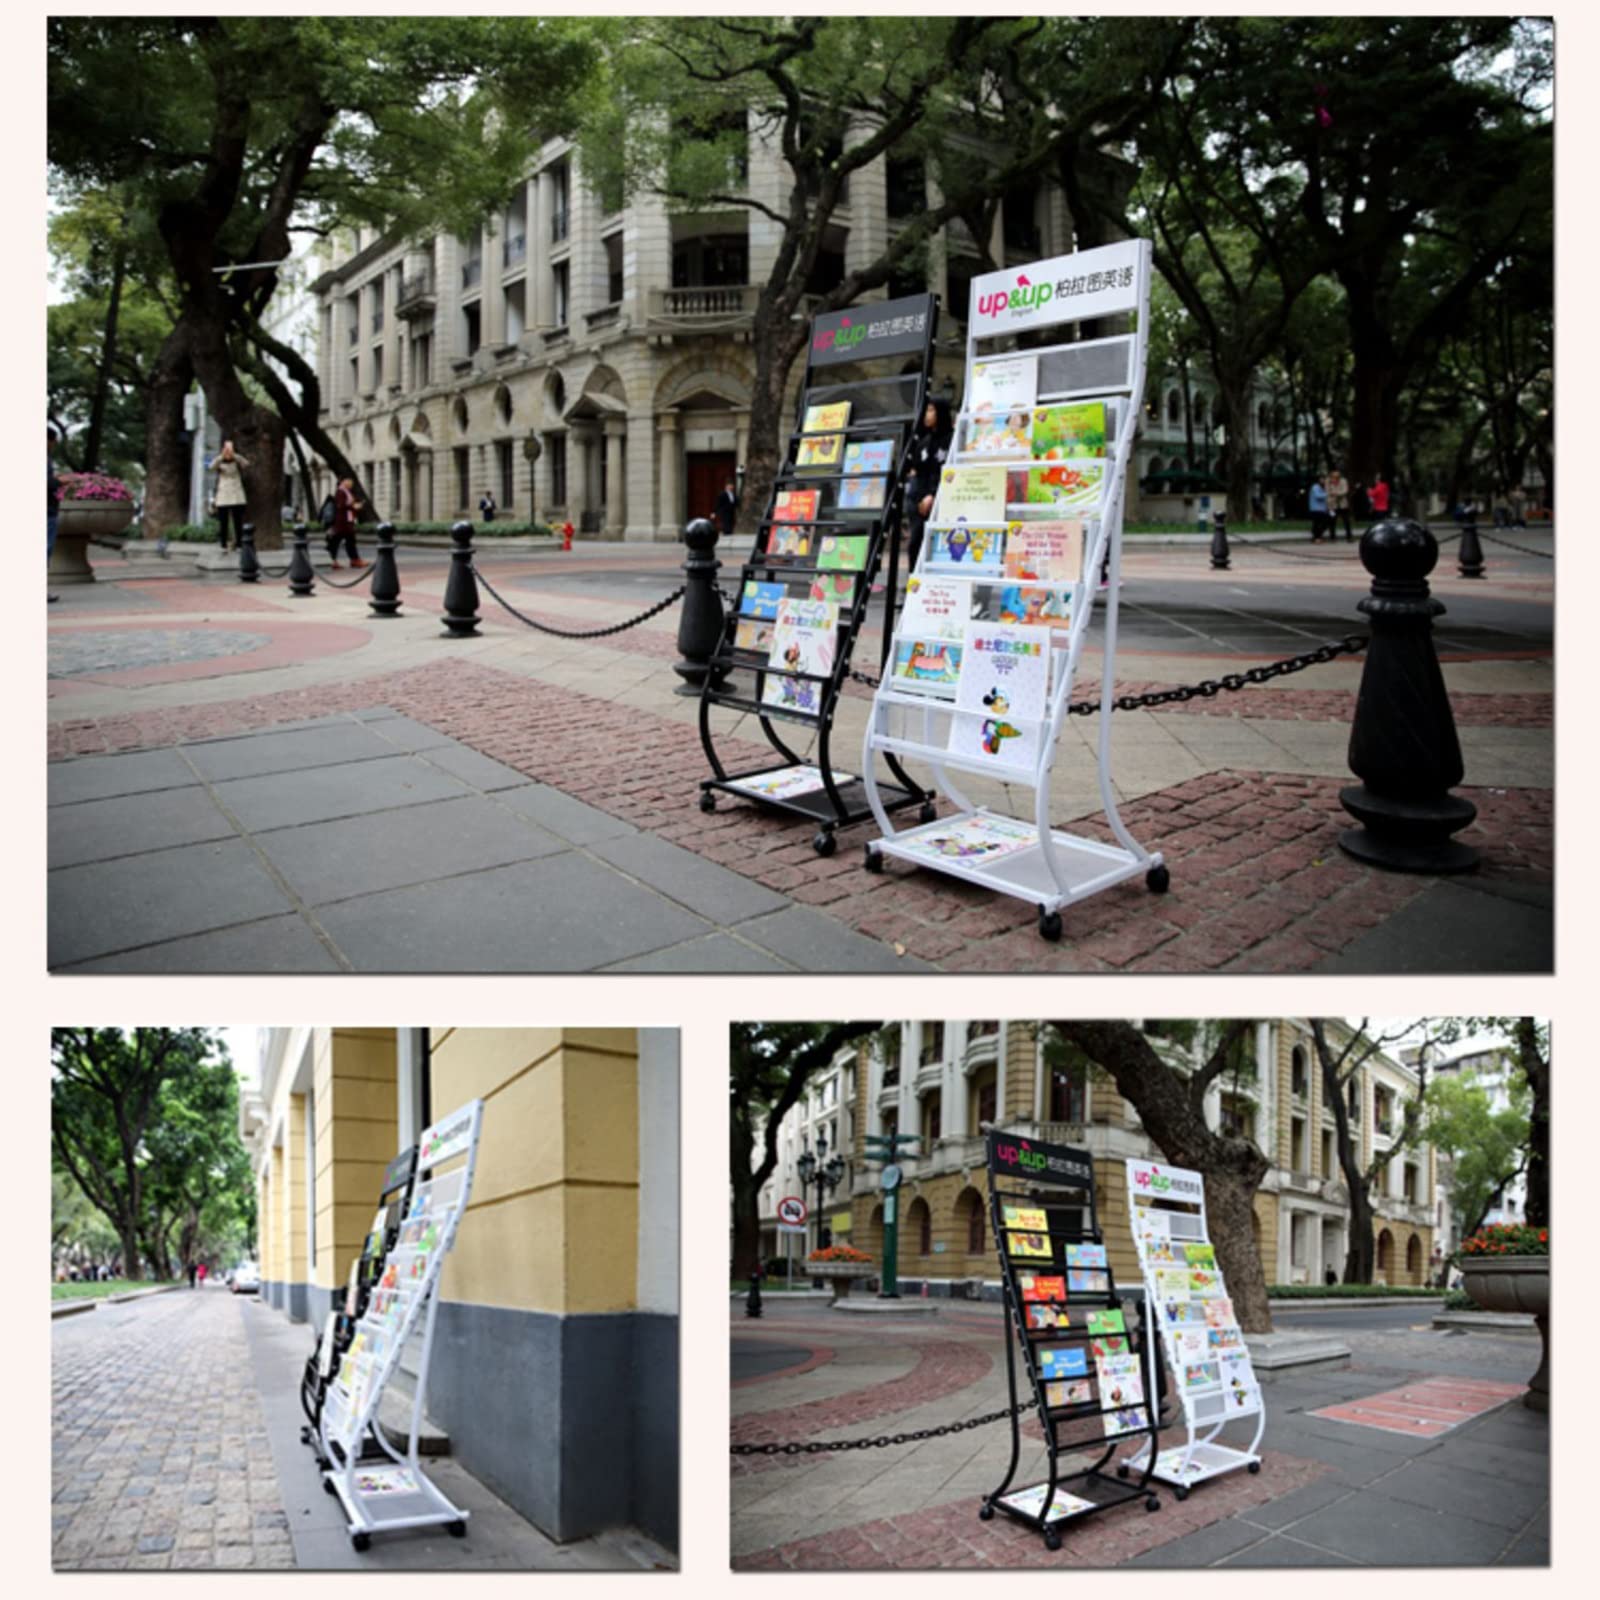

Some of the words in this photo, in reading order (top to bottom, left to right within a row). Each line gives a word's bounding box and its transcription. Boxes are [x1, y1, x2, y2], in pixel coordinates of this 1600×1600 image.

[978, 282, 1053, 319] up&up
[1055, 265, 1133, 300] 柏拉图英语
